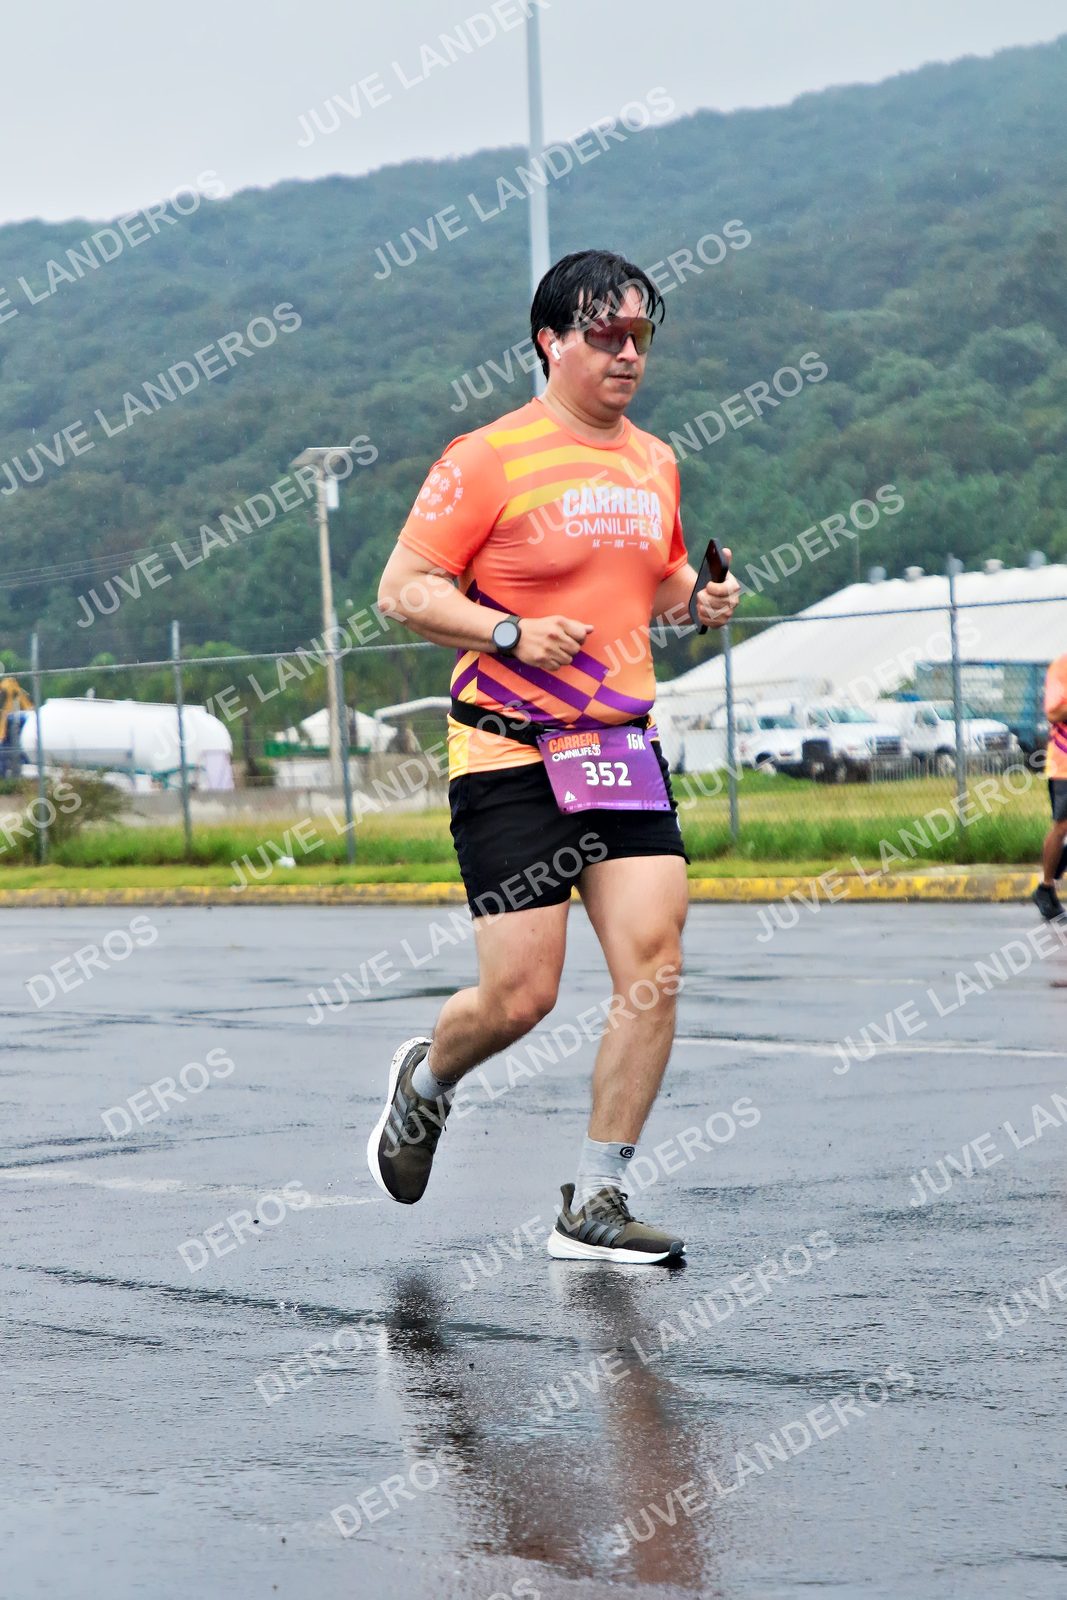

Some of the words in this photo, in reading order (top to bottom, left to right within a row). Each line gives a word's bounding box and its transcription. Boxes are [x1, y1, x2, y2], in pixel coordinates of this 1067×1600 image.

[563, 485, 661, 518] CARRERA
[565, 517, 648, 537] OMNILIFE
[548, 732, 600, 753] CARRERA
[552, 746, 592, 762] OMNILIFE
[581, 761, 632, 786] 352
